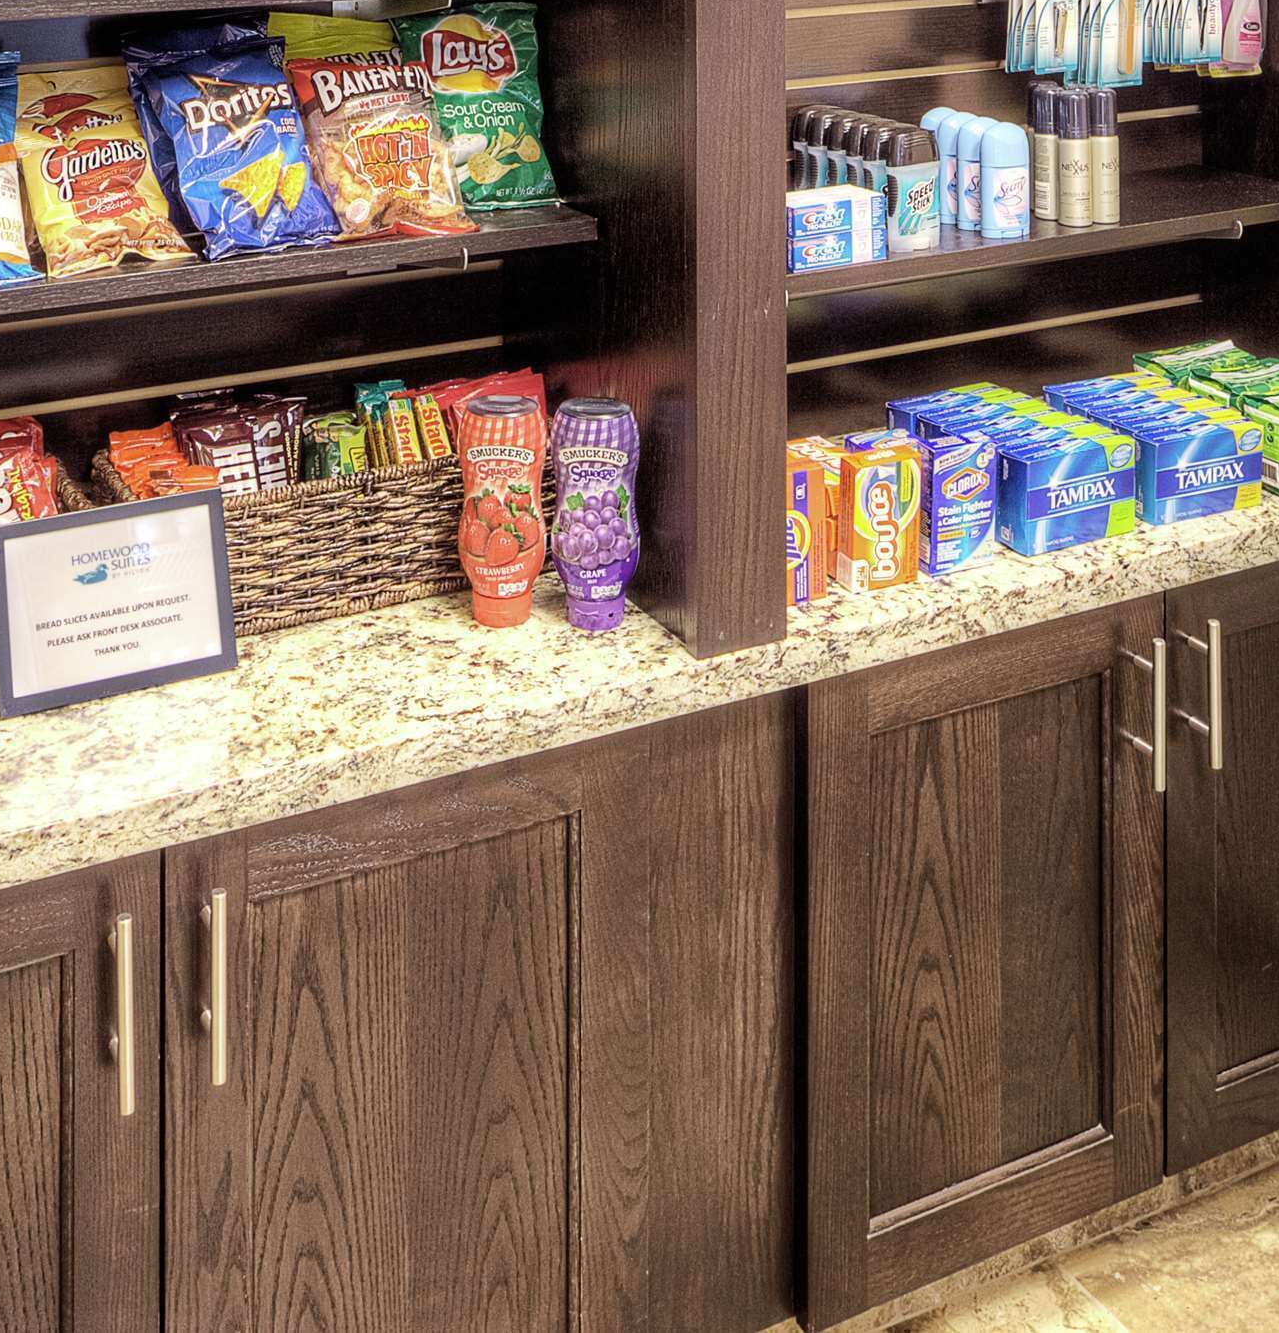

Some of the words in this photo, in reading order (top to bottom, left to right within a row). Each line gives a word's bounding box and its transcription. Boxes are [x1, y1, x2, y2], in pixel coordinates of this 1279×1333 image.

[432, 32, 508, 78] Lay's
[184, 84, 292, 132] Doritos
[444, 103, 477, 118] Sour
[482, 100, 525, 112] Cream
[280, 117, 296, 126] COOL
[463, 118, 473, 128] &
[474, 113, 515, 127] Onion
[357, 133, 399, 165] HOT
[42, 140, 145, 202] Gardetto's
[364, 157, 433, 188] SPICY
[907, 177, 935, 205] SPEED
[912, 195, 933, 214] STICK
[803, 207, 845, 227] Crest
[803, 240, 846, 259] Crest
[470, 446, 532, 462] SMUCKER'S
[563, 448, 625, 463] SMUCKER'S
[477, 464, 524, 481] Squeeze
[571, 465, 617, 482] Squeeze
[1175, 461, 1244, 490] TAMPAX
[946, 473, 985, 497] CLOROX
[1047, 478, 1116, 510] TAMPAX
[938, 505, 962, 518] Stain
[963, 500, 992, 514] Fighter
[871, 481, 899, 580] bounce
[943, 516, 962, 526] Color
[72, 542, 150, 566] HOMEWOOD
[112, 554, 151, 571] SUITES
[475, 562, 525, 576] STRAWBERRY
[580, 568, 606, 579] GRAPE
[36, 619, 62, 631] BREAD
[64, 615, 89, 627] SLICES
[89, 606, 131, 621] AVAILABLE
[132, 602, 154, 614] UPON
[156, 594, 192, 609] REQUEST.
[47, 635, 75, 648] PLEASE
[76, 631, 91, 641] ASK
[93, 627, 119, 638] FRONT
[121, 622, 140, 634] DESK
[141, 614, 184, 629] ASSOCIATE.
[94, 645, 121, 657] THANK
[122, 642, 141, 652] YOU.
